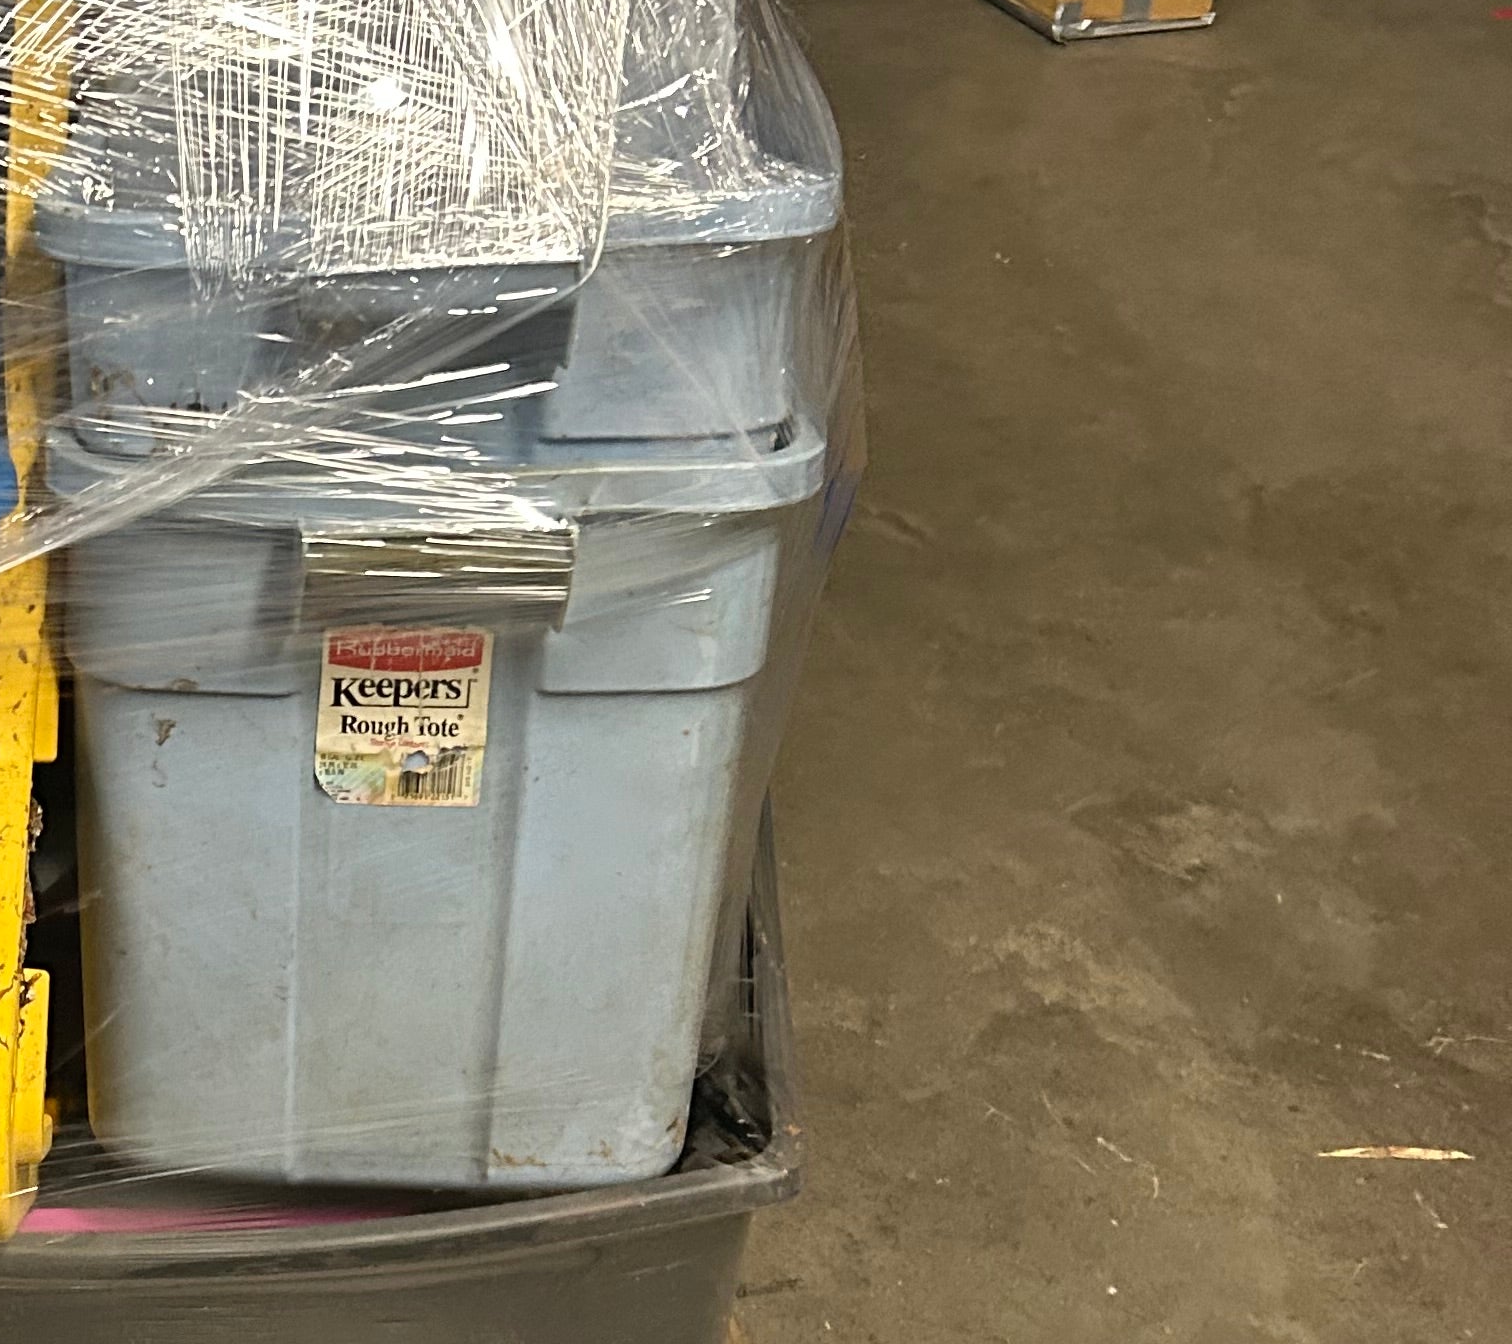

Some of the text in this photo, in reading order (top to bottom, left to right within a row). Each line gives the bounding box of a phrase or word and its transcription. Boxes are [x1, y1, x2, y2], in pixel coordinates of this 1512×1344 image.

[336, 637, 476, 657] Rubbermaid
[330, 676, 462, 707] Keepers
[339, 714, 460, 742] Rough Tote
